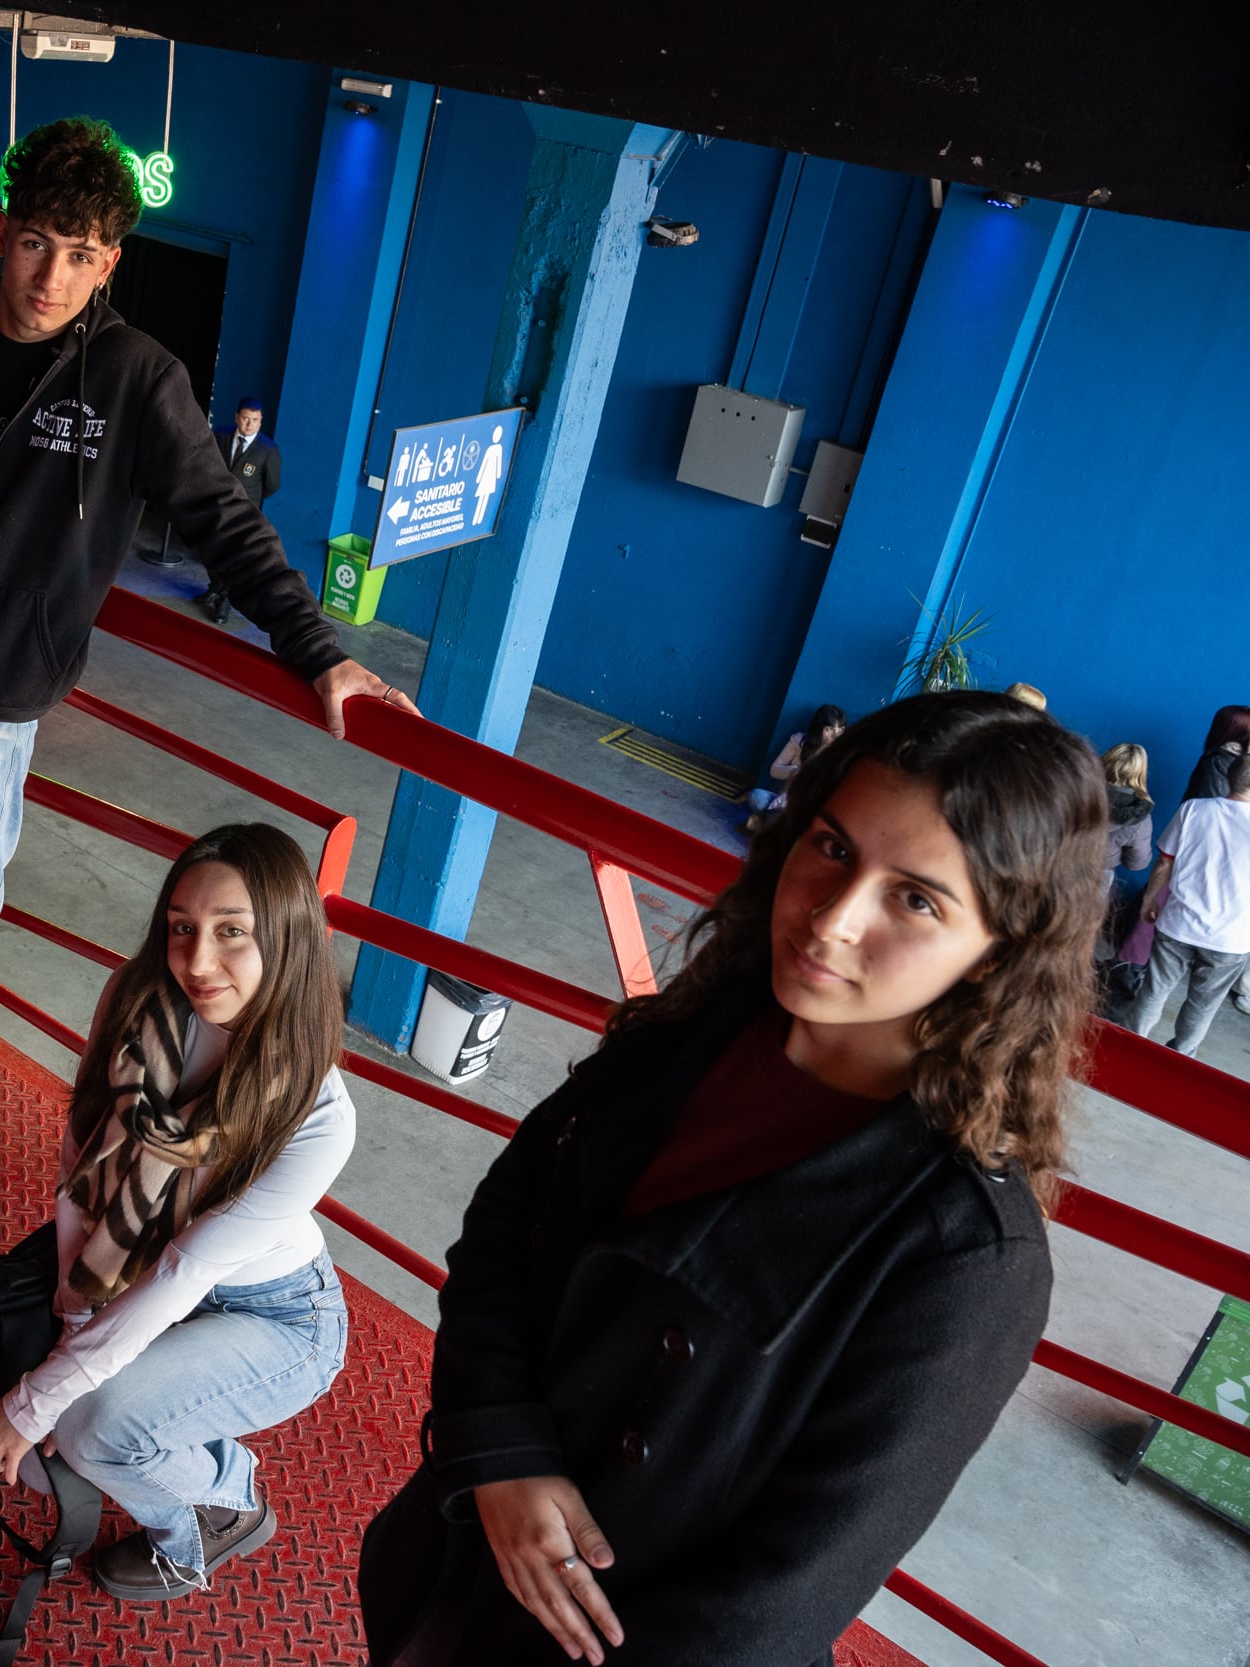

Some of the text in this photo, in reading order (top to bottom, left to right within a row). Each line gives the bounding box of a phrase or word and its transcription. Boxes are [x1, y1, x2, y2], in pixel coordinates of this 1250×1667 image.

[33, 408, 106, 438] ACTIVE IFE
[50, 440, 98, 459] ATHLEICS
[414, 481, 465, 504] SANITARIO
[409, 497, 463, 522] ACCESIBLE
